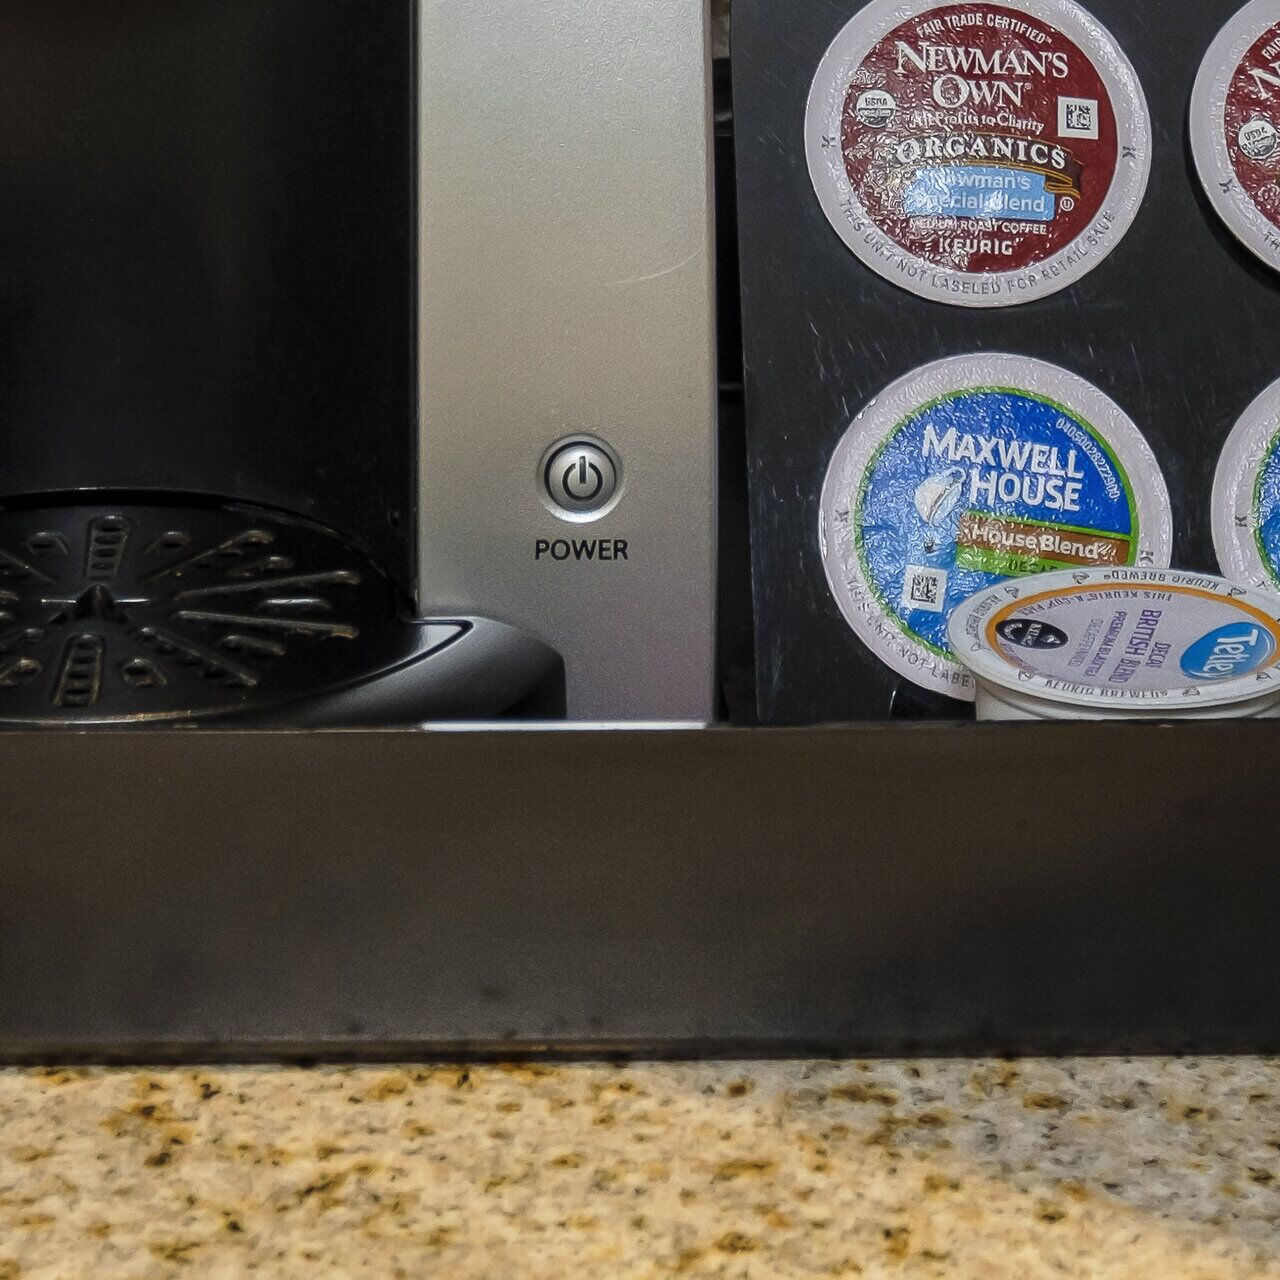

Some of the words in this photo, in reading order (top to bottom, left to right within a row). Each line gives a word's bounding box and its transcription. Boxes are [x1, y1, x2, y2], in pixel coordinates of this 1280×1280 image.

[915, 18, 945, 39] FAIR
[945, 13, 983, 29] TRADE
[893, 40, 1069, 78] NEWMAN'S
[997, 111, 1045, 135] Charity
[896, 135, 1067, 169] ORGANICS
[961, 220, 999, 232] ROAST
[1001, 222, 1048, 236] COFFEE
[896, 258, 928, 282] NOT
[1008, 273, 1037, 294] FOR
[1042, 248, 1089, 281] RETAIL
[921, 423, 1085, 479] MAXWELL
[970, 470, 1083, 512] HOUSE
[535, 539, 629, 561] POWER
[971, 524, 1038, 549] House
[1039, 533, 1099, 560] Blend
[1124, 609, 1163, 657] BRITISH
[1196, 629, 1259, 677] Tetley
[931, 666, 975, 689] LABE
